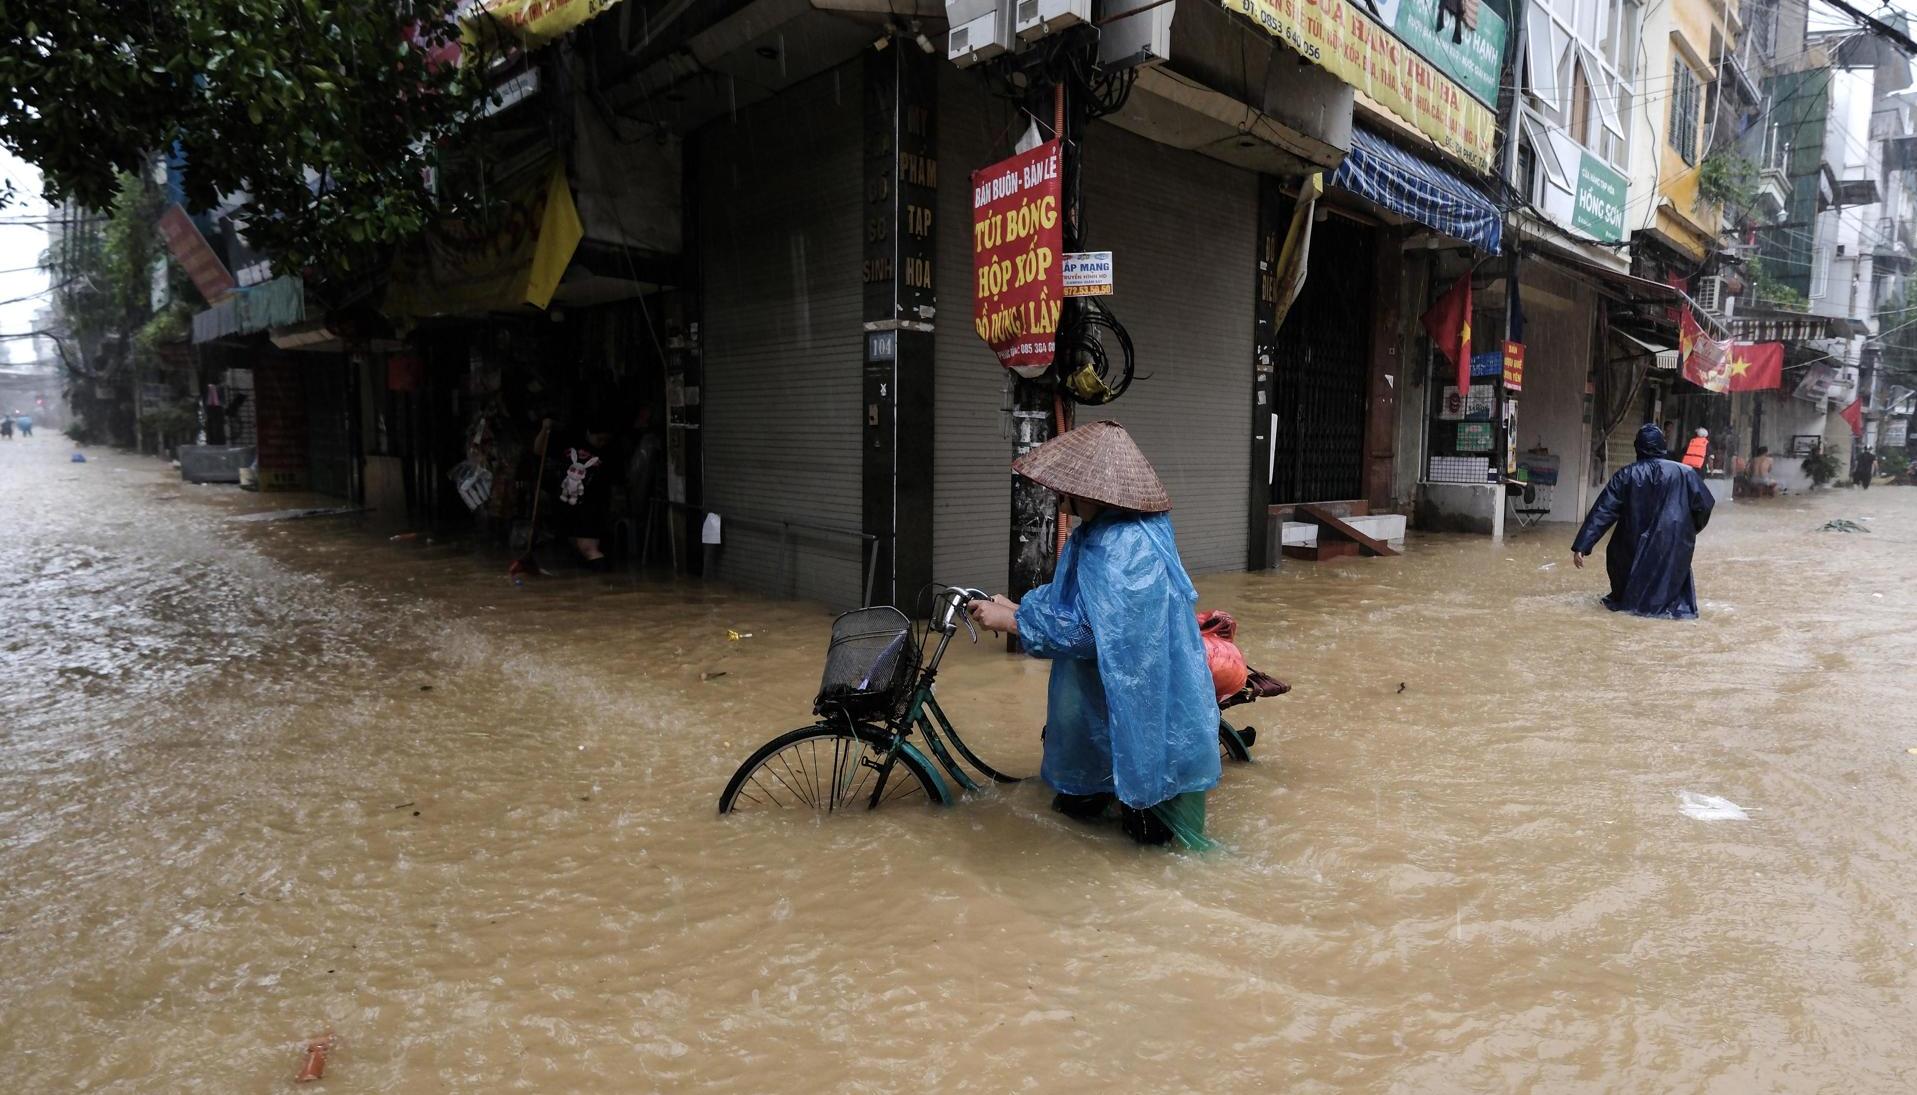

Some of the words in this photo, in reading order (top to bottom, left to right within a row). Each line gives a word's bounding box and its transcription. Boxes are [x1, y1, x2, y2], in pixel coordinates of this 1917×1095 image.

[1260, 9, 1283, 34] 0853
[1286, 26, 1302, 49] 640
[1303, 40, 1321, 60] 056
[974, 181, 991, 209] BÁN
[992, 170, 1018, 201] BUÔN
[1023, 160, 1043, 190] BÁN
[1043, 146, 1058, 181] LẺ
[906, 204, 934, 240] TẠP
[975, 209, 1003, 253] TÚI
[1005, 195, 1058, 242] BÓNG
[1579, 186, 1605, 219] HỒNG
[1604, 204, 1622, 229] SƠN
[862, 258, 893, 283] SINH
[904, 250, 932, 289] HÓA
[978, 254, 1012, 302] HỘP
[1014, 234, 1053, 289] XỐP
[1080, 262, 1110, 274] MẠNG
[1028, 285, 1061, 335] LẦN
[872, 338, 892, 355] 104
